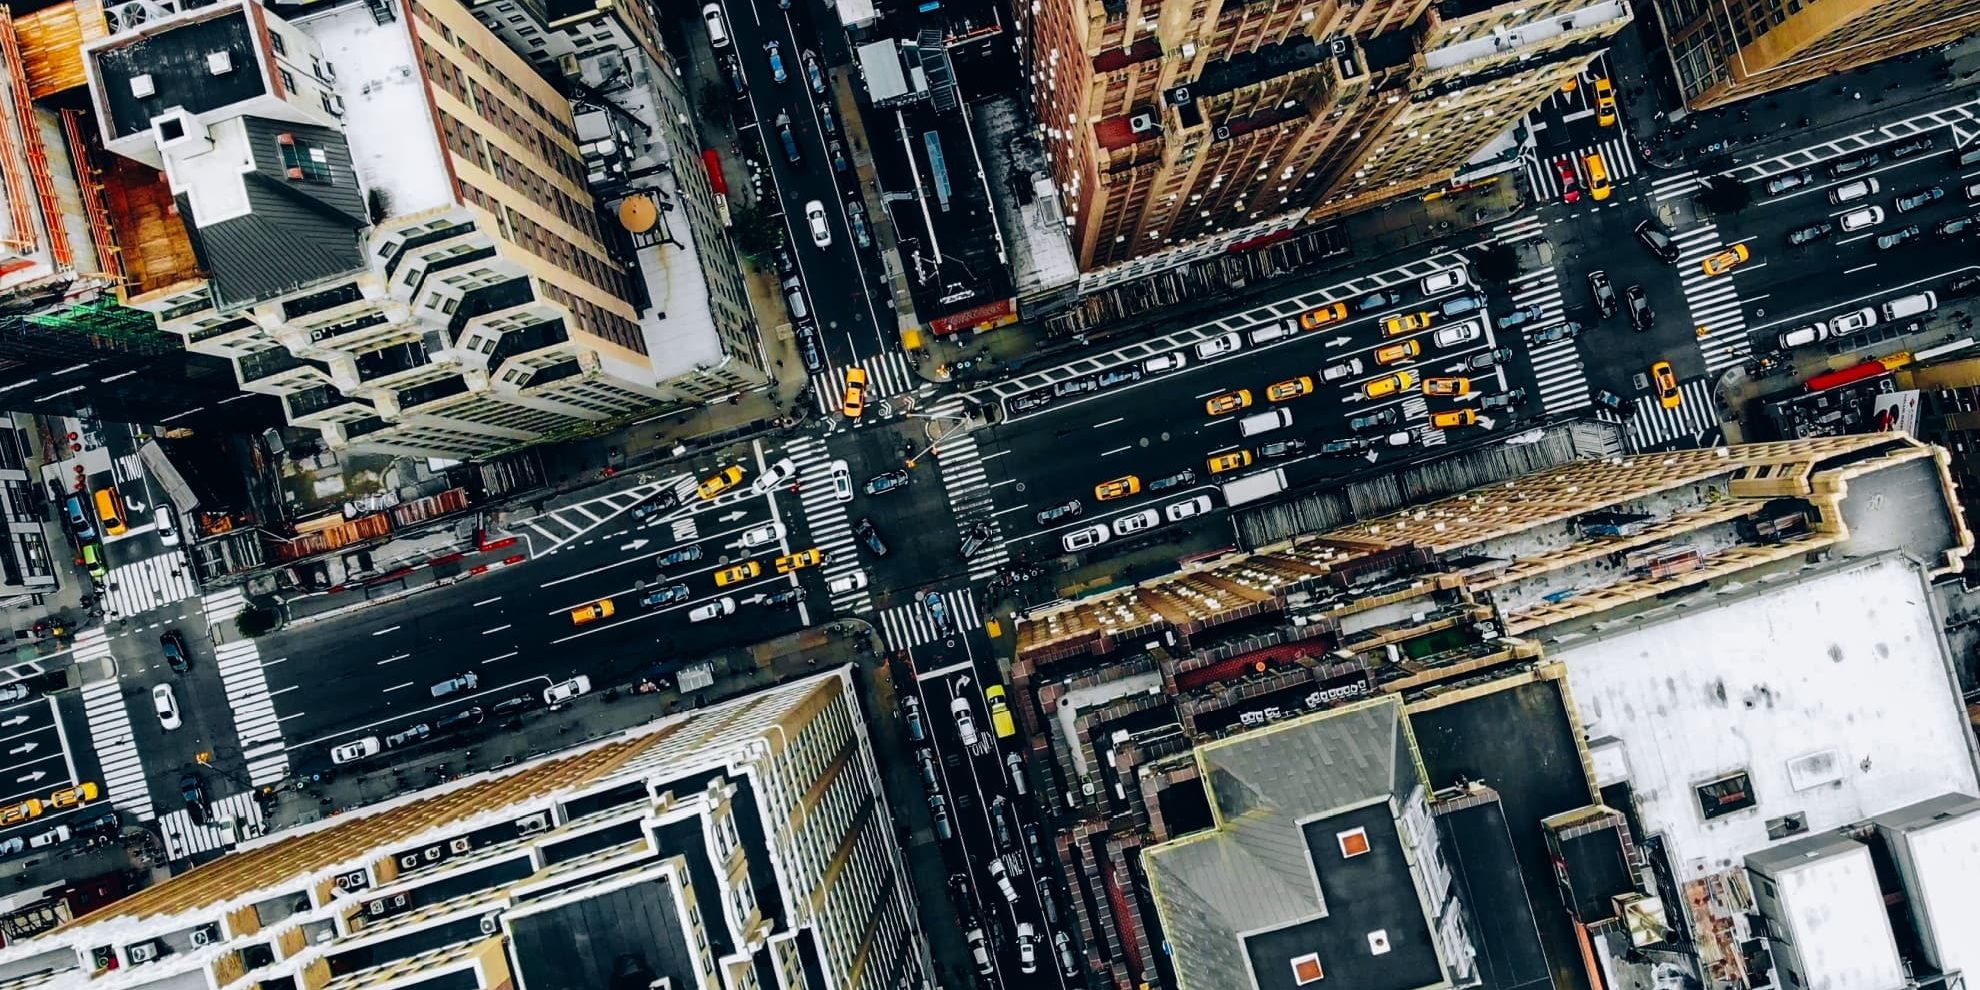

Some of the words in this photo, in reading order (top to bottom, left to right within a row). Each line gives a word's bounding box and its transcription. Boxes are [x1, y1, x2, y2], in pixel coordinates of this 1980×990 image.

[1401, 397, 1429, 422] ONLY
[114, 453, 142, 484] ONLY
[671, 518, 699, 542] ONLY
